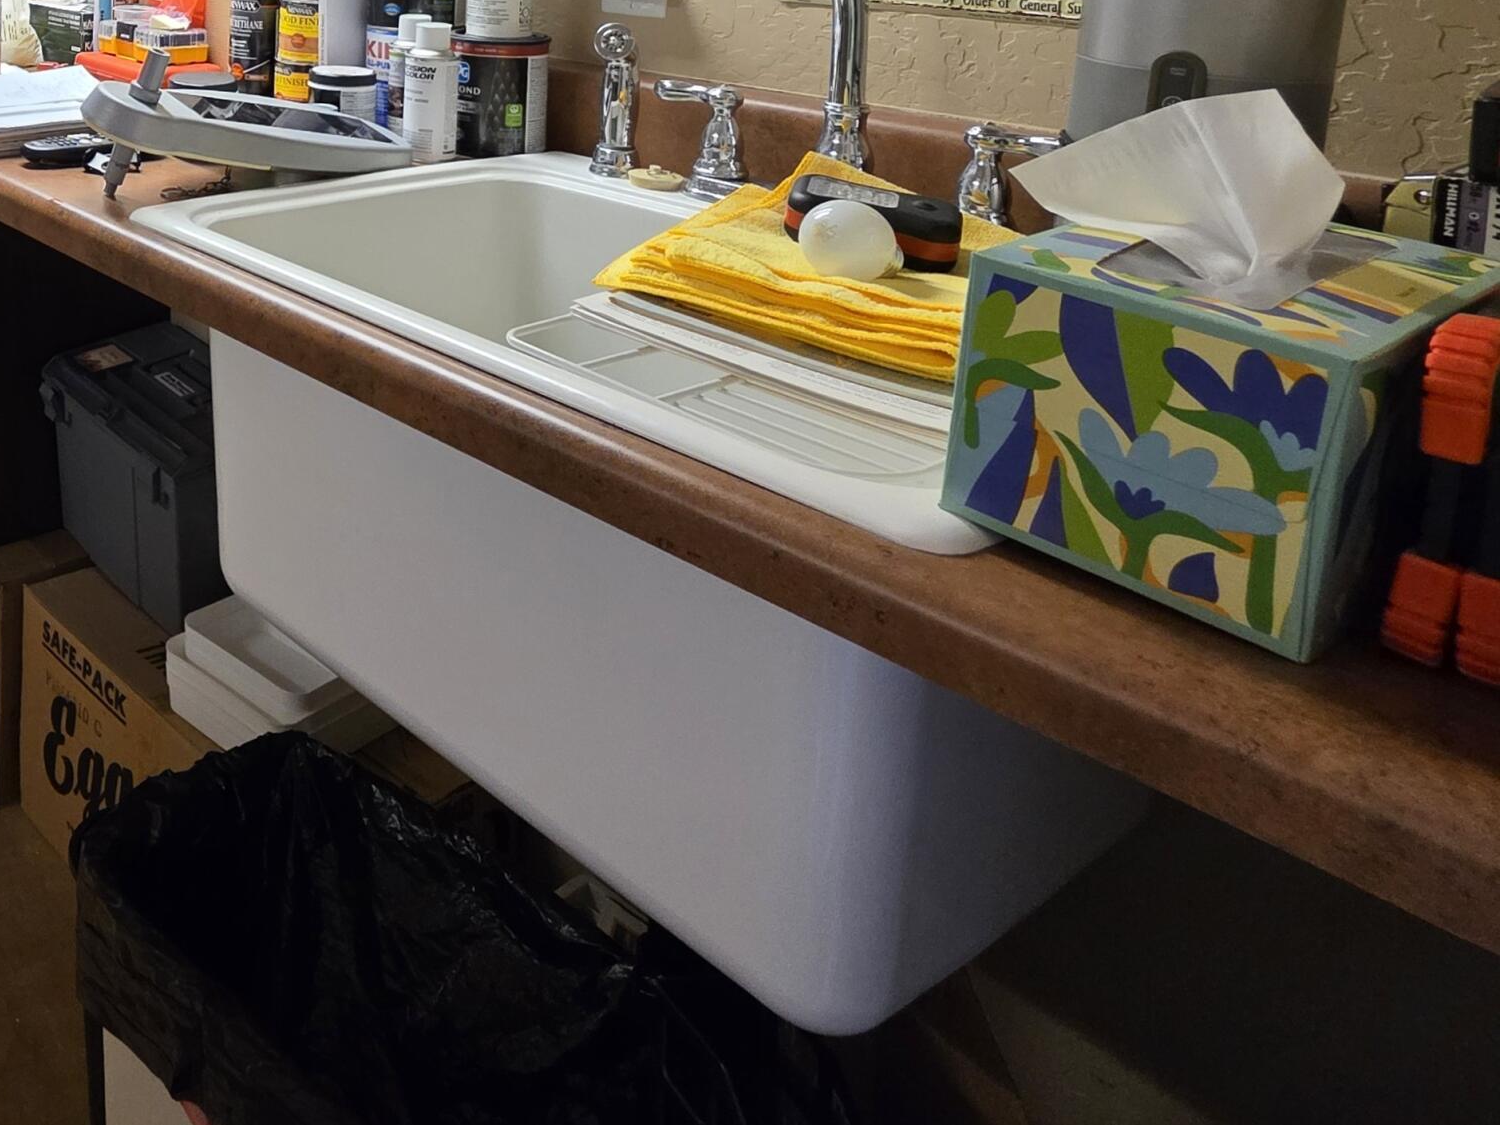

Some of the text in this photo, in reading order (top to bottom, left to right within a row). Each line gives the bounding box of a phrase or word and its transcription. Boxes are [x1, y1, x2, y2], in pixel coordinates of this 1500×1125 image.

[1067, 1, 1082, 14] Su
[1443, 183, 1459, 237] HILLMAN
[42, 620, 128, 719] SAFE-PACK
